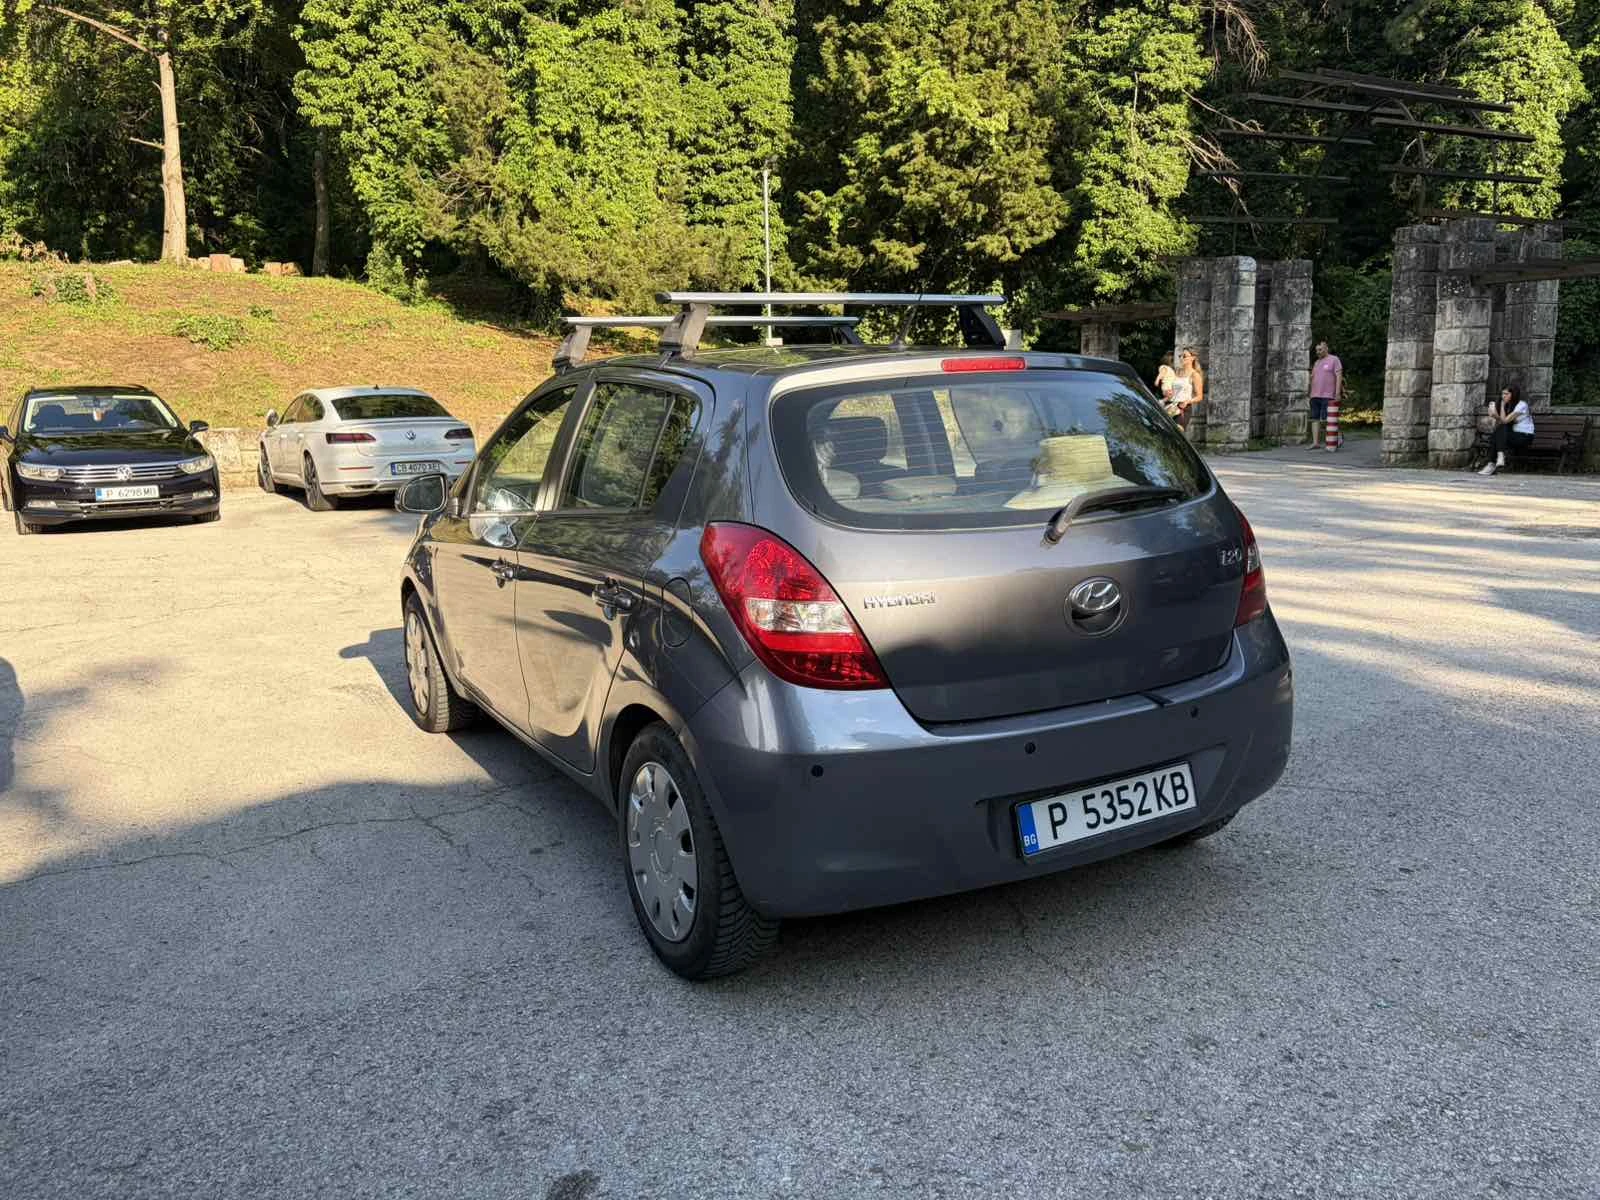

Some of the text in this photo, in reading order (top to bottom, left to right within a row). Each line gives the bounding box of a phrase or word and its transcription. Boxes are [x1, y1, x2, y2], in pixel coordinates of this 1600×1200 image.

[863, 591, 936, 609] HYUNDAI
[1048, 802, 1067, 840] P
[1023, 833, 1037, 847] BG
